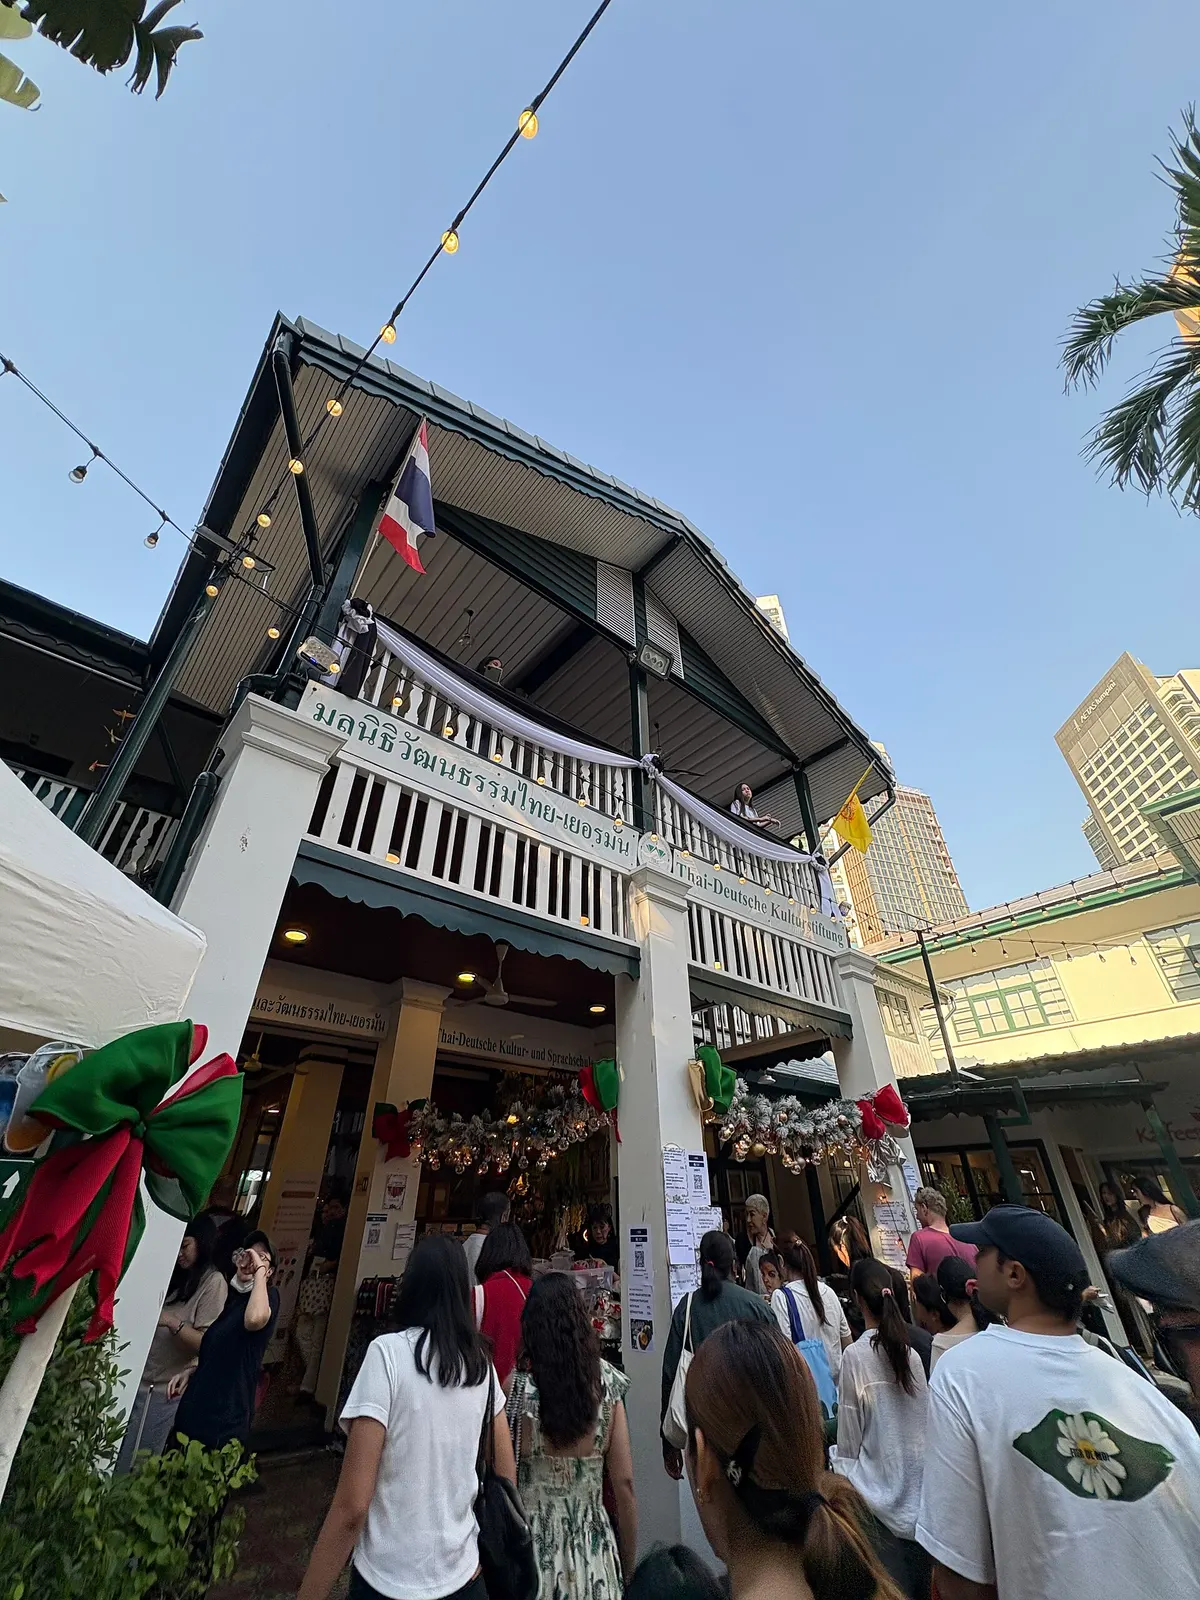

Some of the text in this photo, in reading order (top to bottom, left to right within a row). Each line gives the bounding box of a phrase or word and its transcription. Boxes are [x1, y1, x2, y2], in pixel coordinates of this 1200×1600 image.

[676, 860, 844, 948] Thai-Deutsche Kulturstiftung
[499, 1039, 530, 1058] Kultur-
[530, 1049, 547, 1061] und
[547, 1050, 594, 1068] Sprachschul
